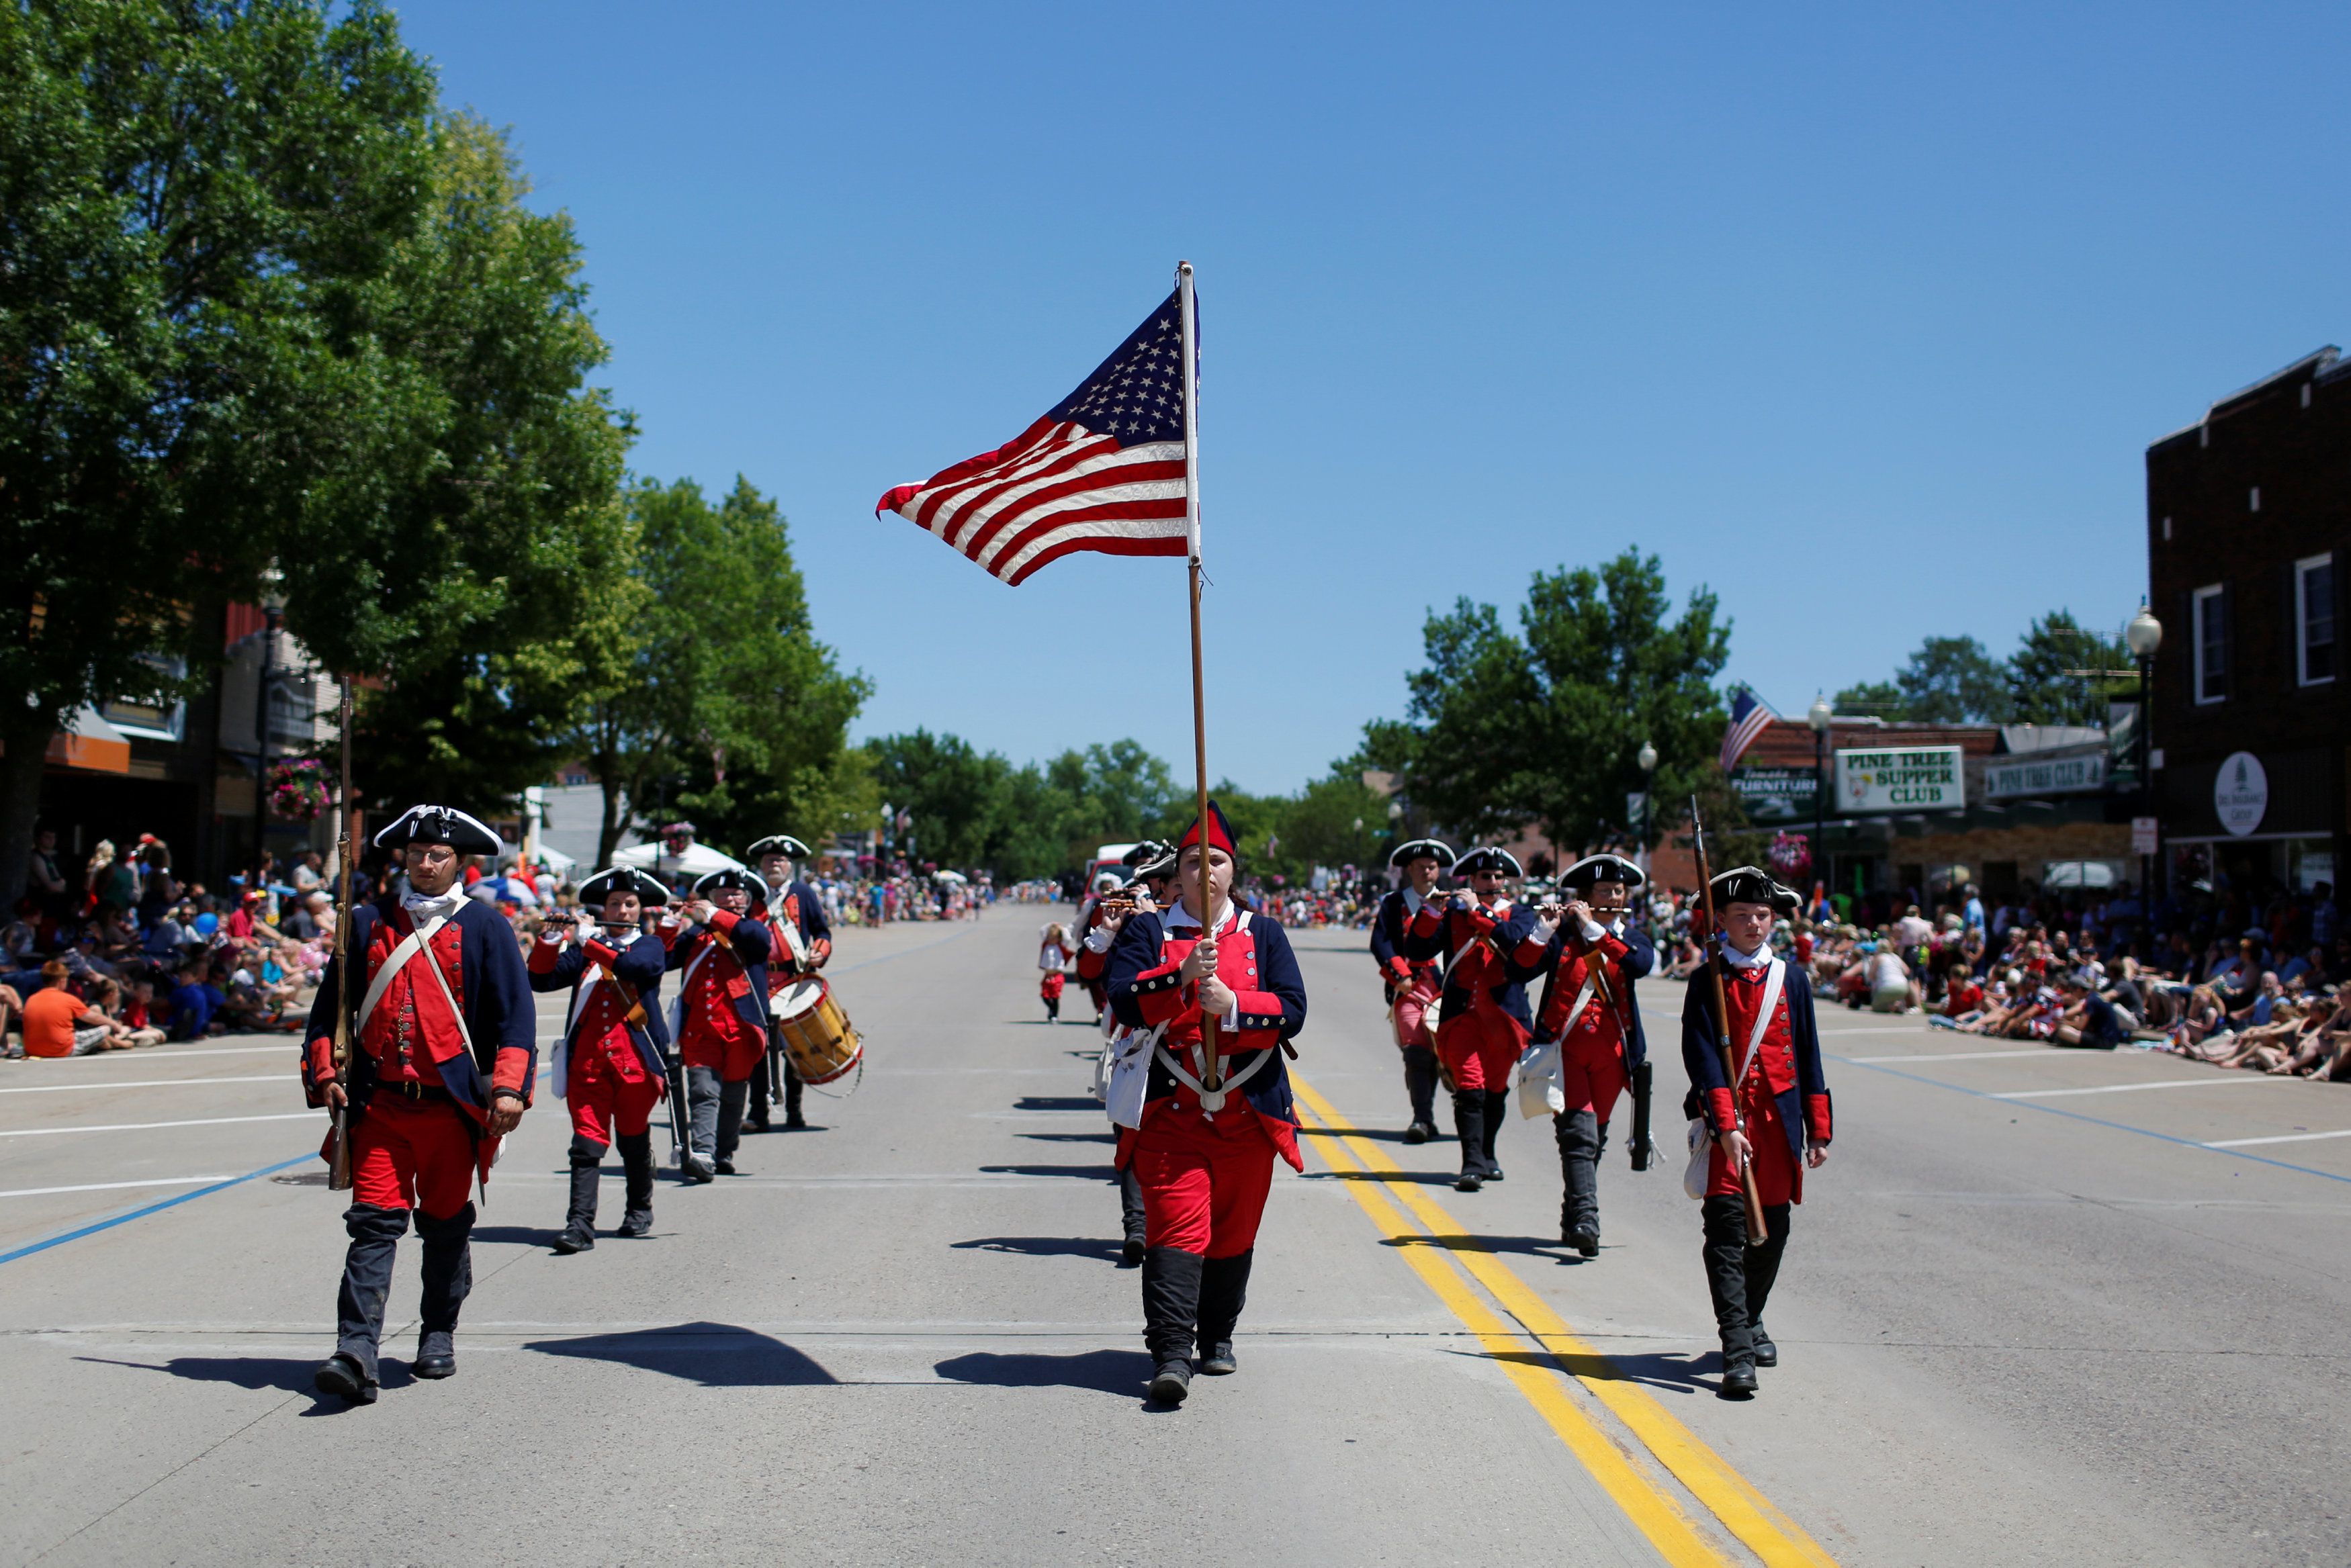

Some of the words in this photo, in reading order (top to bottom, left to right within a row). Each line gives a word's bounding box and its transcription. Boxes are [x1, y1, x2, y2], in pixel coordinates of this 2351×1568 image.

[1848, 753, 1893, 769] PINE
[1898, 751, 1953, 767] TREE
[1875, 770, 1953, 786] SUPPER
[1999, 768, 2023, 792] PINE
[2055, 760, 2084, 786] CLUB
[1890, 787, 1943, 803] CLUB
